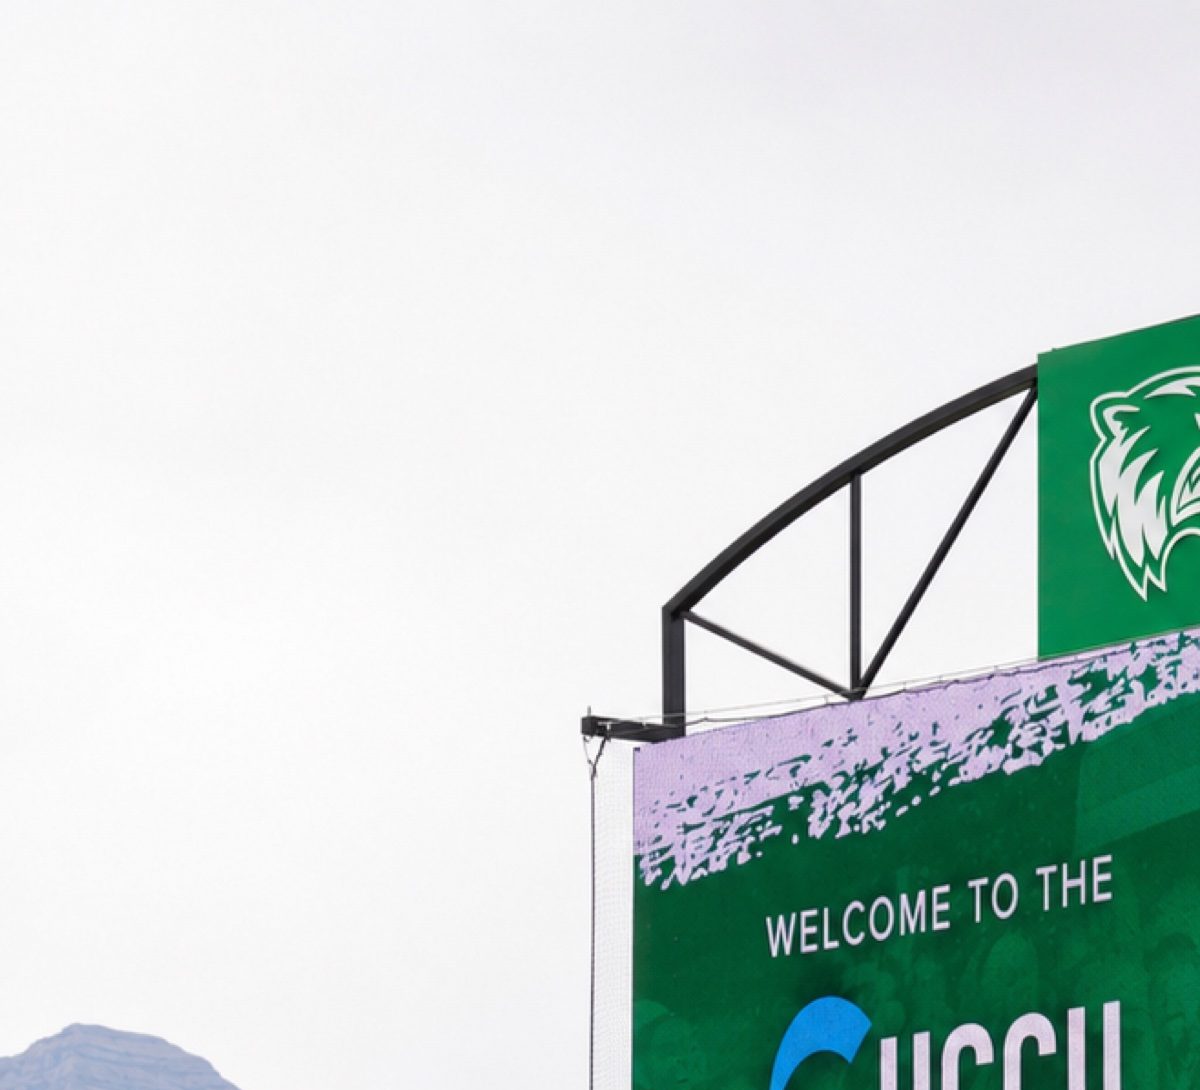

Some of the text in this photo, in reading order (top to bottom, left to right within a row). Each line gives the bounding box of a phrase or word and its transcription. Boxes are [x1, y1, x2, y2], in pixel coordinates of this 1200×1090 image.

[766, 854, 1113, 957] WELCOME TO THE
